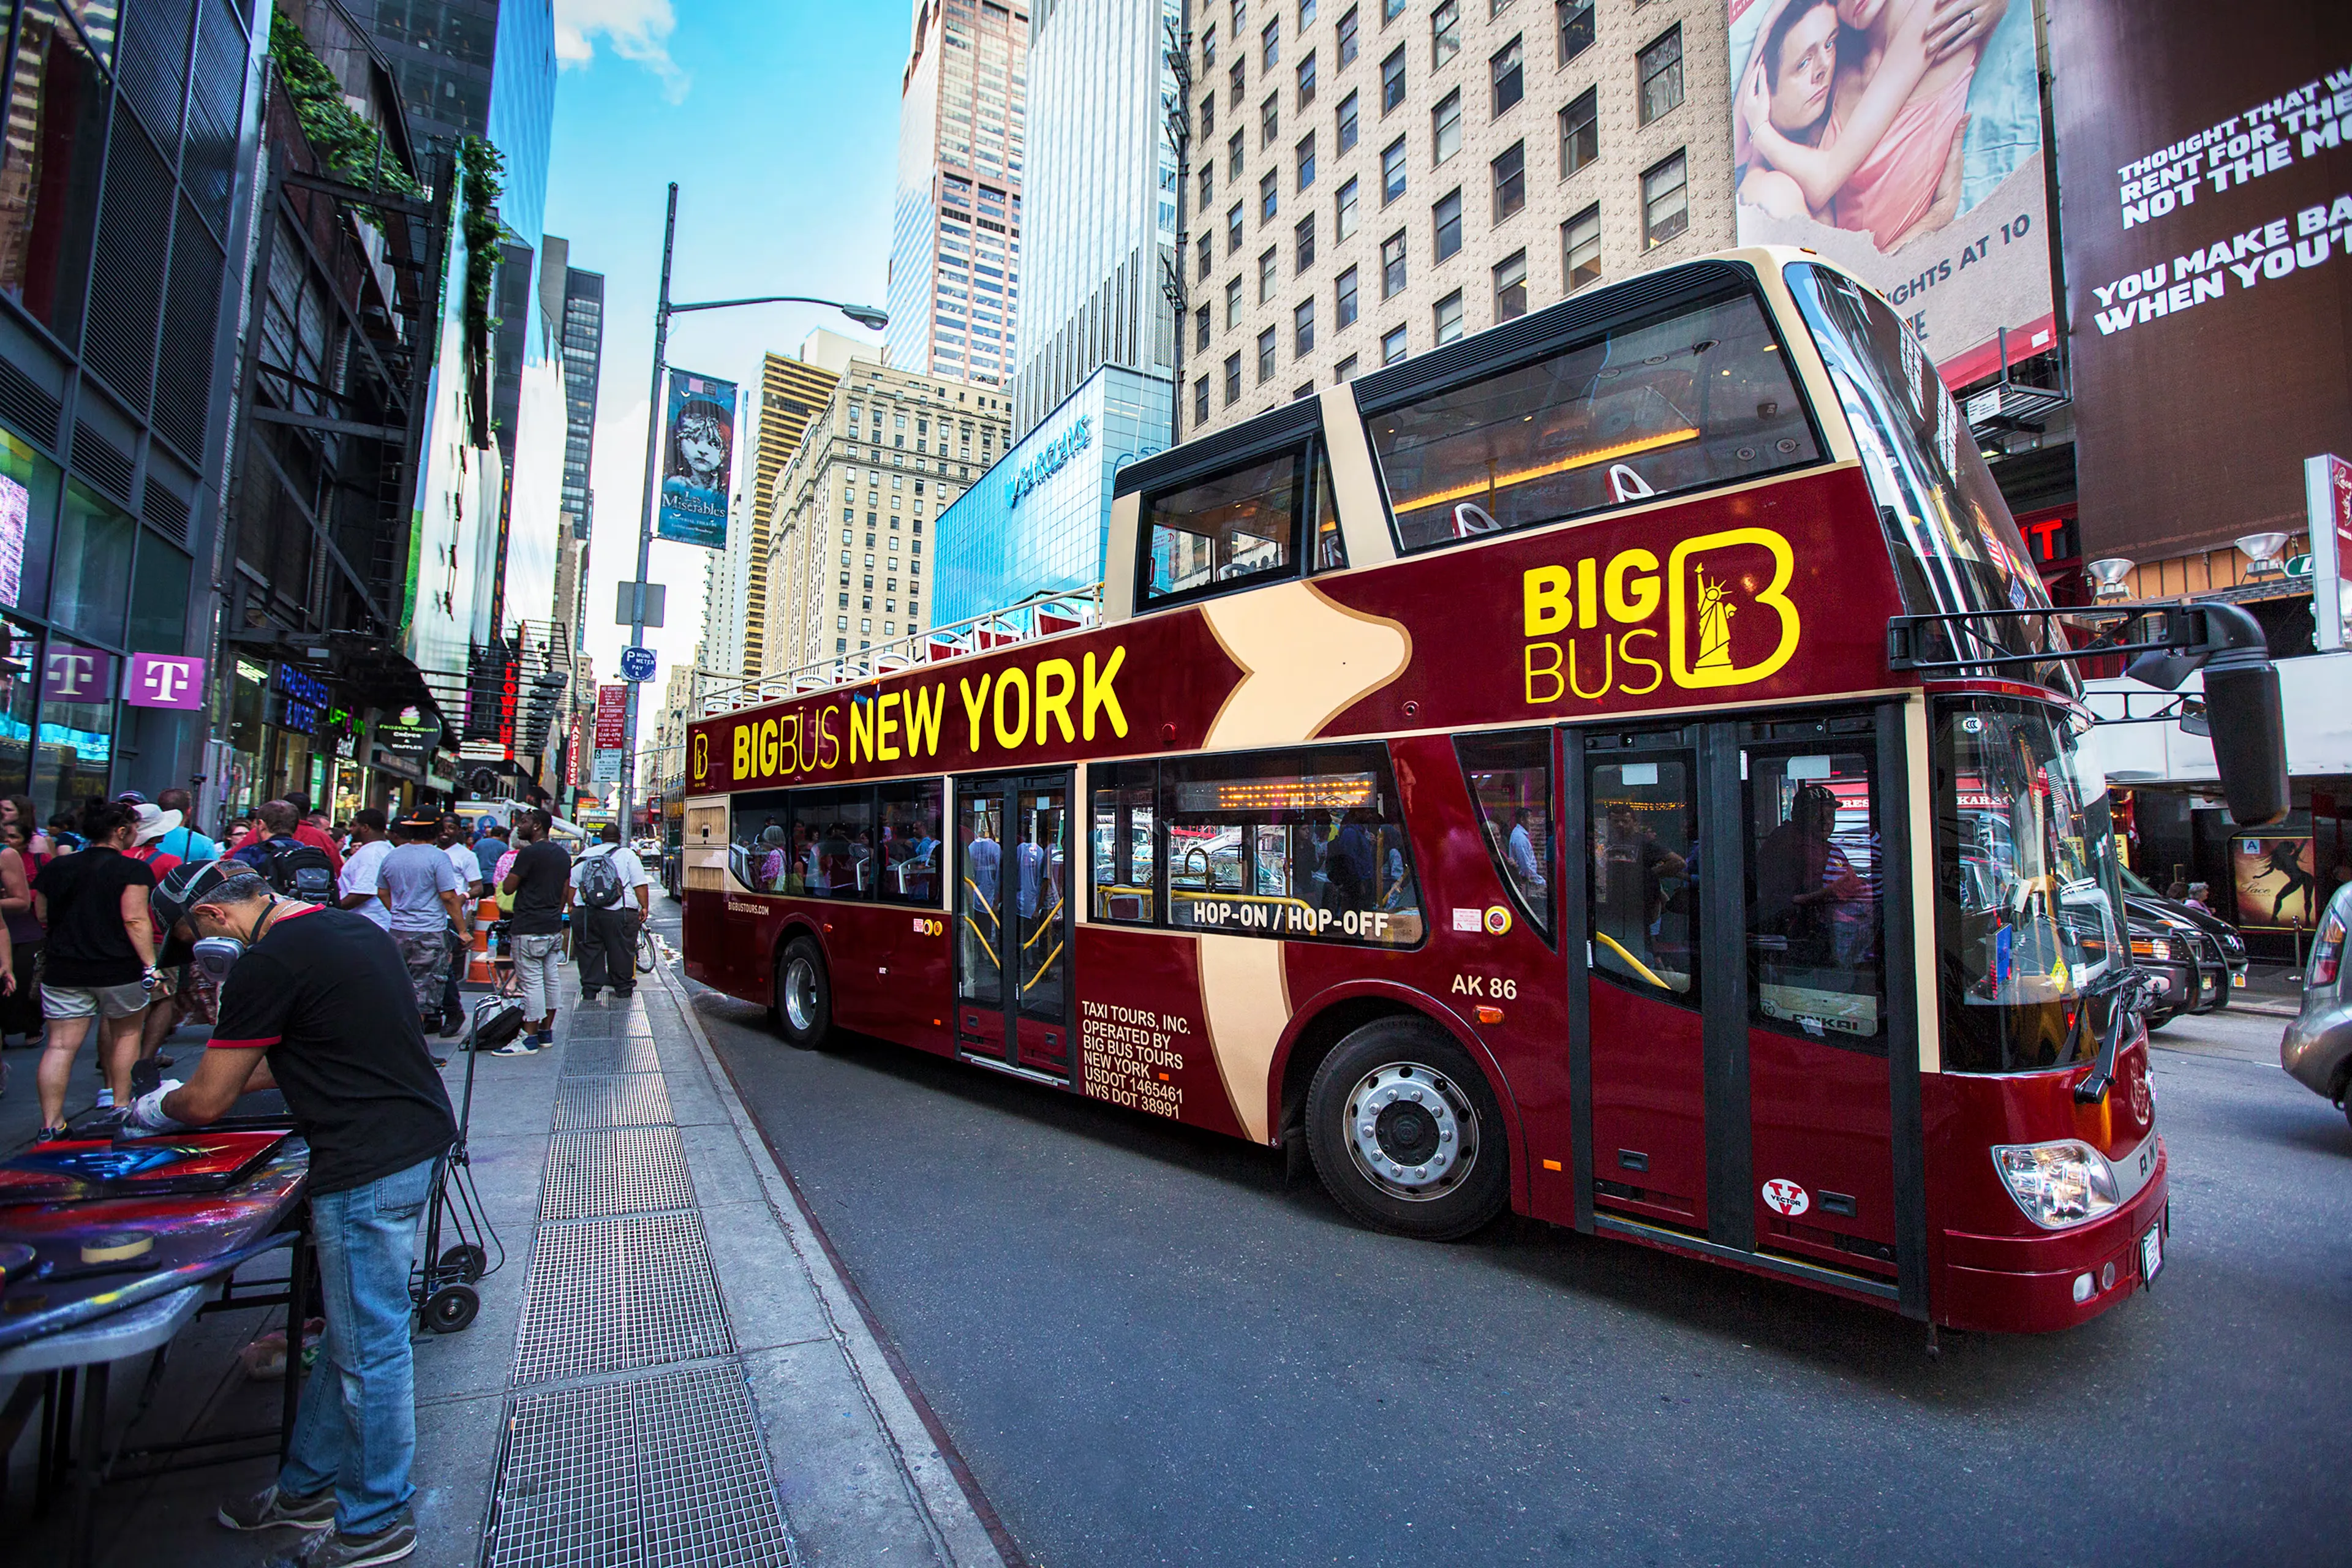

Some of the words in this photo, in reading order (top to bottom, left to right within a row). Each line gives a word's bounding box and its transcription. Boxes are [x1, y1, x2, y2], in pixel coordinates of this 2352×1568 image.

[2117, 116, 2240, 182] THOUGHT
[2243, 80, 2320, 127] THAT
[2120, 153, 2203, 205] RENT
[2209, 123, 2276, 167] FOR
[2122, 176, 2200, 230] NOT
[2206, 138, 2292, 192] THE
[1959, 235, 1990, 270] AT
[2000, 214, 2030, 245] 10
[2092, 263, 2167, 307] YOU
[2174, 217, 2290, 281] MAKE
[2094, 270, 2225, 336] WHEN
[1017, 414, 1088, 495] BARCLAYS
[685, 491, 701, 503] Les
[1523, 548, 1661, 638] BIG
[627, 650, 635, 662] P
[1525, 628, 1664, 704] BUS
[144, 660, 189, 702] T
[329, 706, 366, 736] UPTOWN
[733, 705, 840, 780] BIGBUS
[850, 682, 946, 764] NEW
[960, 645, 1129, 753] YORK
[595, 750, 600, 758] 6
[728, 901, 769, 916] BIGBUSTOURS.COM
[1194, 901, 1267, 928] HOP-ON
[1288, 907, 1389, 937] HOP-OFF
[1451, 974, 1483, 997] AK
[1490, 978, 1517, 1000] 86
[1082, 1000, 1107, 1019] TAXI
[1110, 1005, 1159, 1031] TOURS,
[1163, 1014, 1191, 1035] INC.
[1082, 1019, 1150, 1046] OPERATED
[1153, 1033, 1171, 1050] BY
[1084, 1035, 1104, 1052] BIG
[1107, 1039, 1133, 1058] BUS
[1136, 1046, 1183, 1069] TOURS
[1084, 1050, 1111, 1069] NEW
[1114, 1057, 1150, 1079] YORK
[1085, 1065, 1126, 1088] USDOT
[1130, 1077, 1183, 1104] 1465461
[1085, 1080, 1109, 1100] NYS
[1112, 1088, 1138, 1107] DOT
[1141, 1096, 1179, 1119] 38991
[1770, 1194, 1801, 1207] VECTOR
